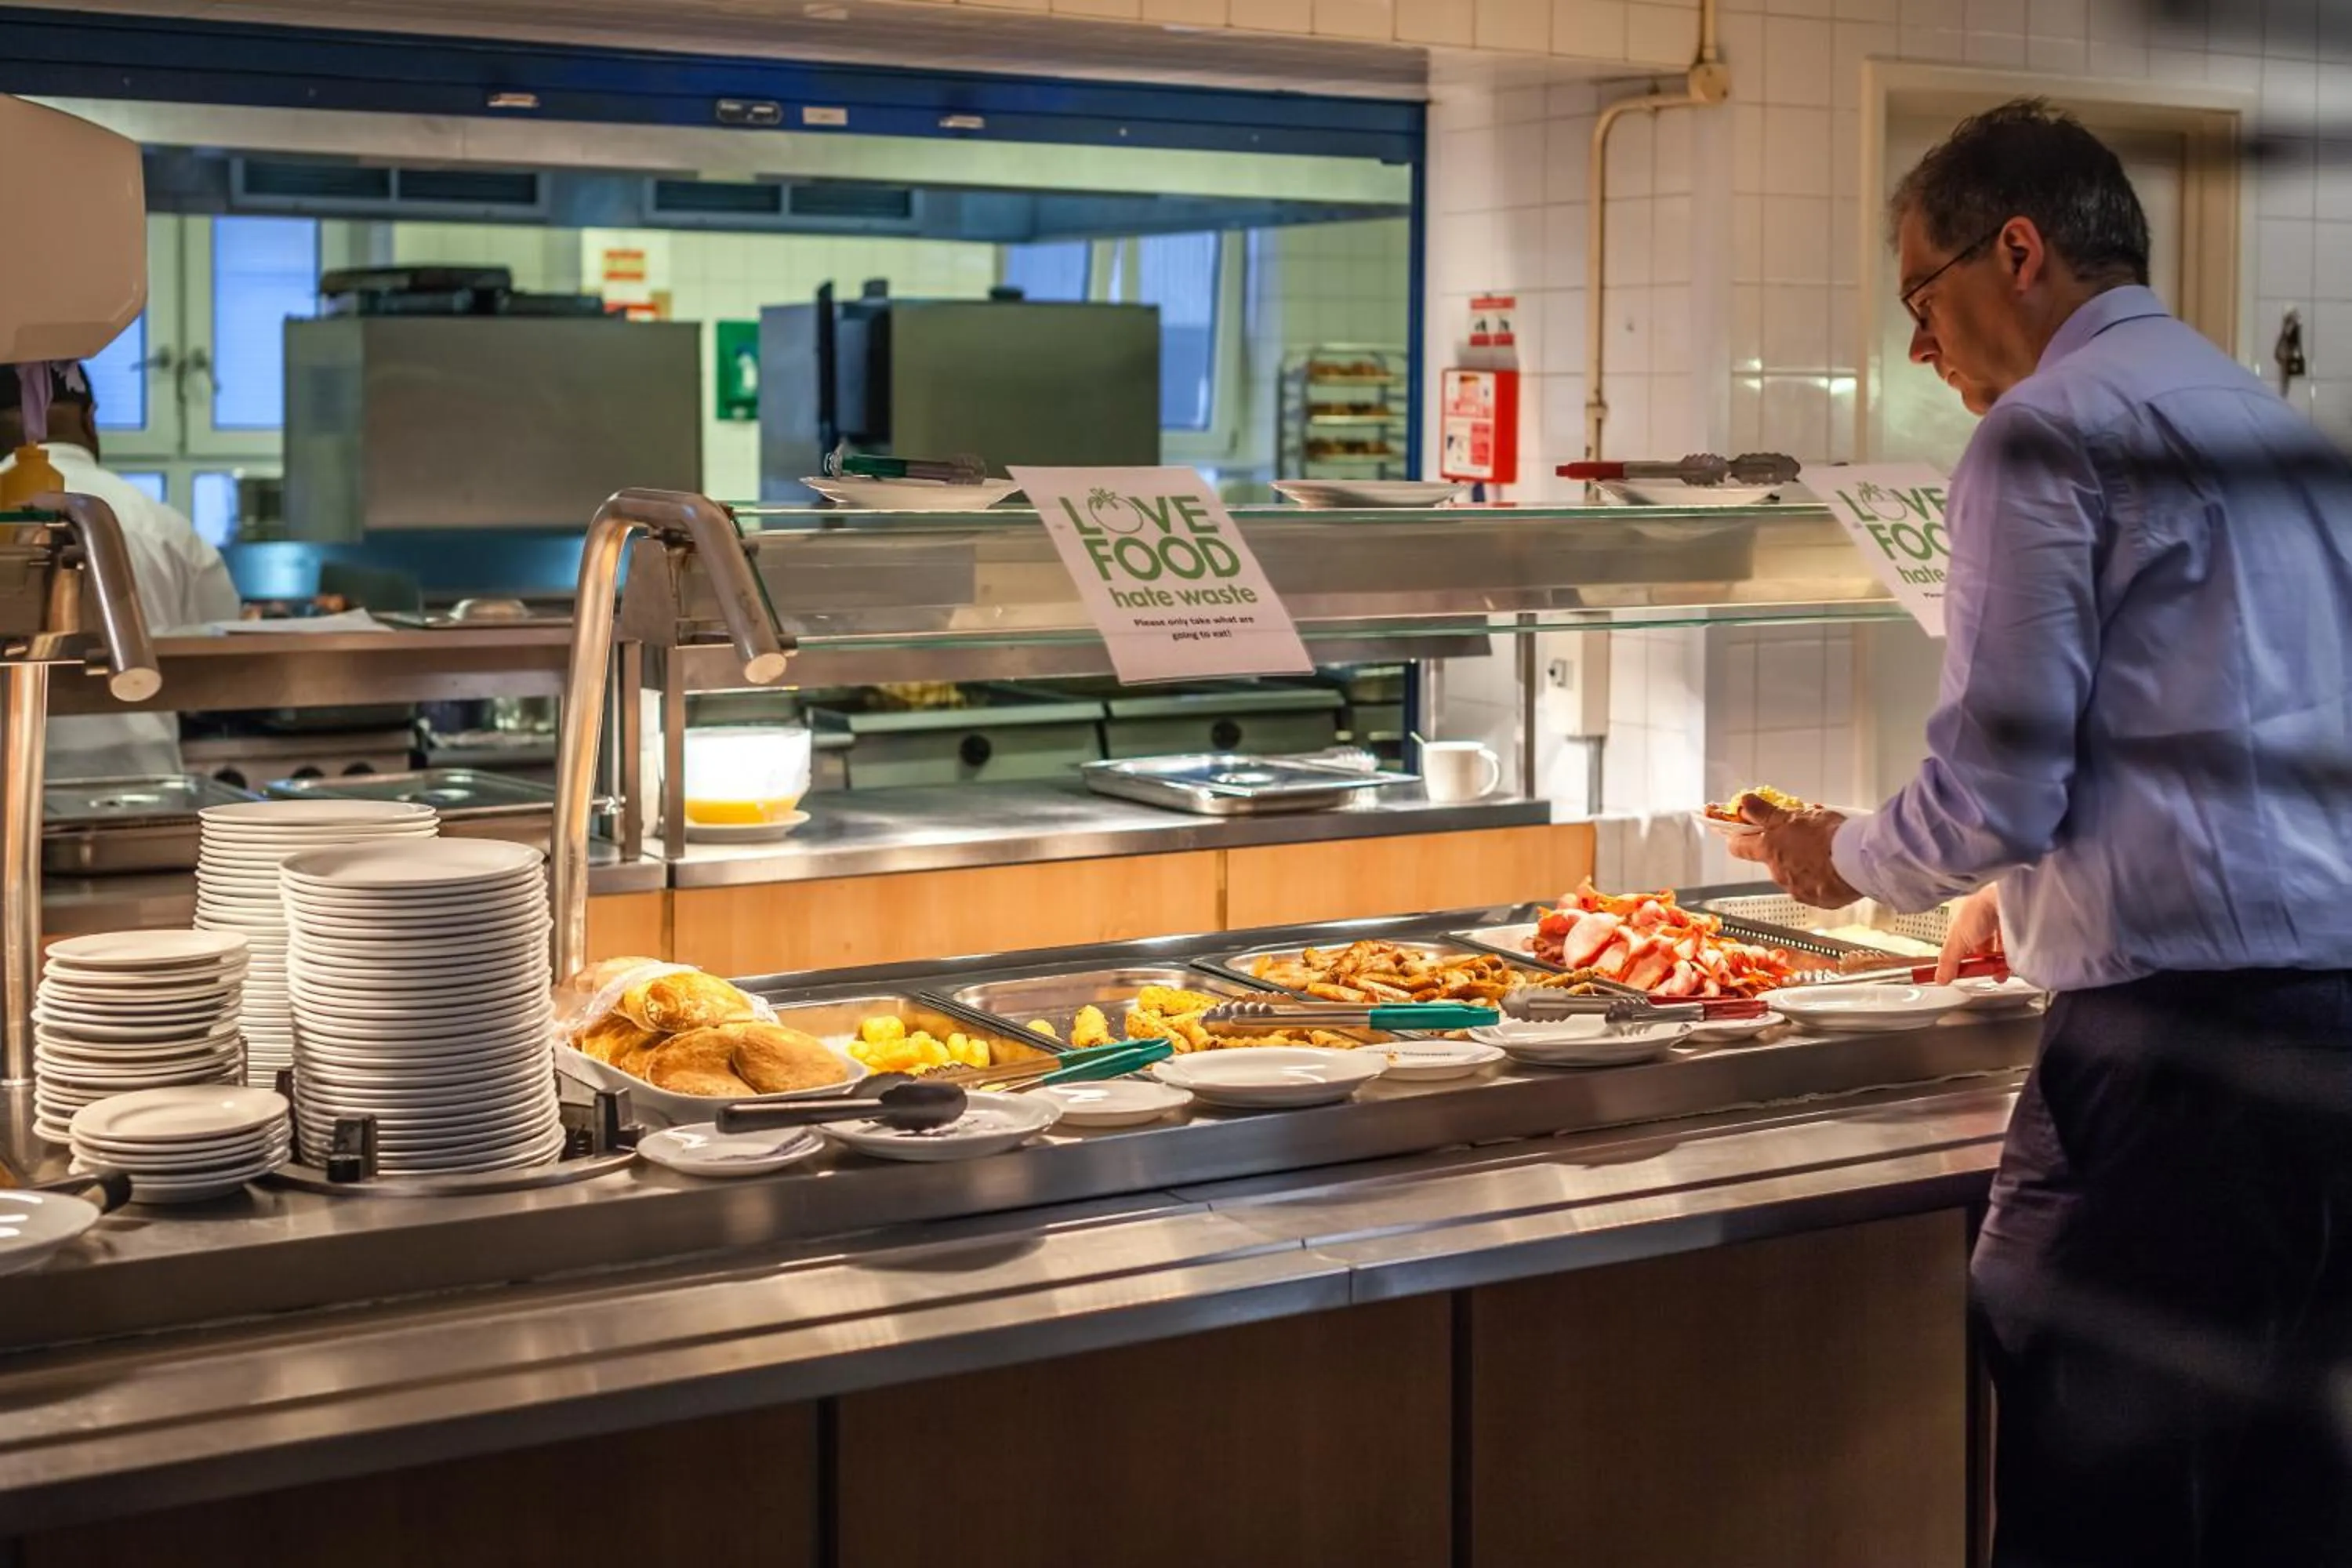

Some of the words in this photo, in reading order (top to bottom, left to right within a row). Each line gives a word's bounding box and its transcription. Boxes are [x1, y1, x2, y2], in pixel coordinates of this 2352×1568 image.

[1059, 488, 1219, 535] LOVE
[1865, 521, 1952, 561] FOO
[1082, 536, 1241, 582] FOOD
[1896, 564, 1947, 585] hate
[1109, 586, 1173, 609] hate
[1176, 583, 1258, 608] waste
[1134, 618, 1166, 626] Please
[1167, 617, 1188, 626] only
[1189, 616, 1211, 625] take
[1213, 615, 1237, 624] what
[1172, 630, 1199, 641] going
[1200, 630, 1210, 639] to
